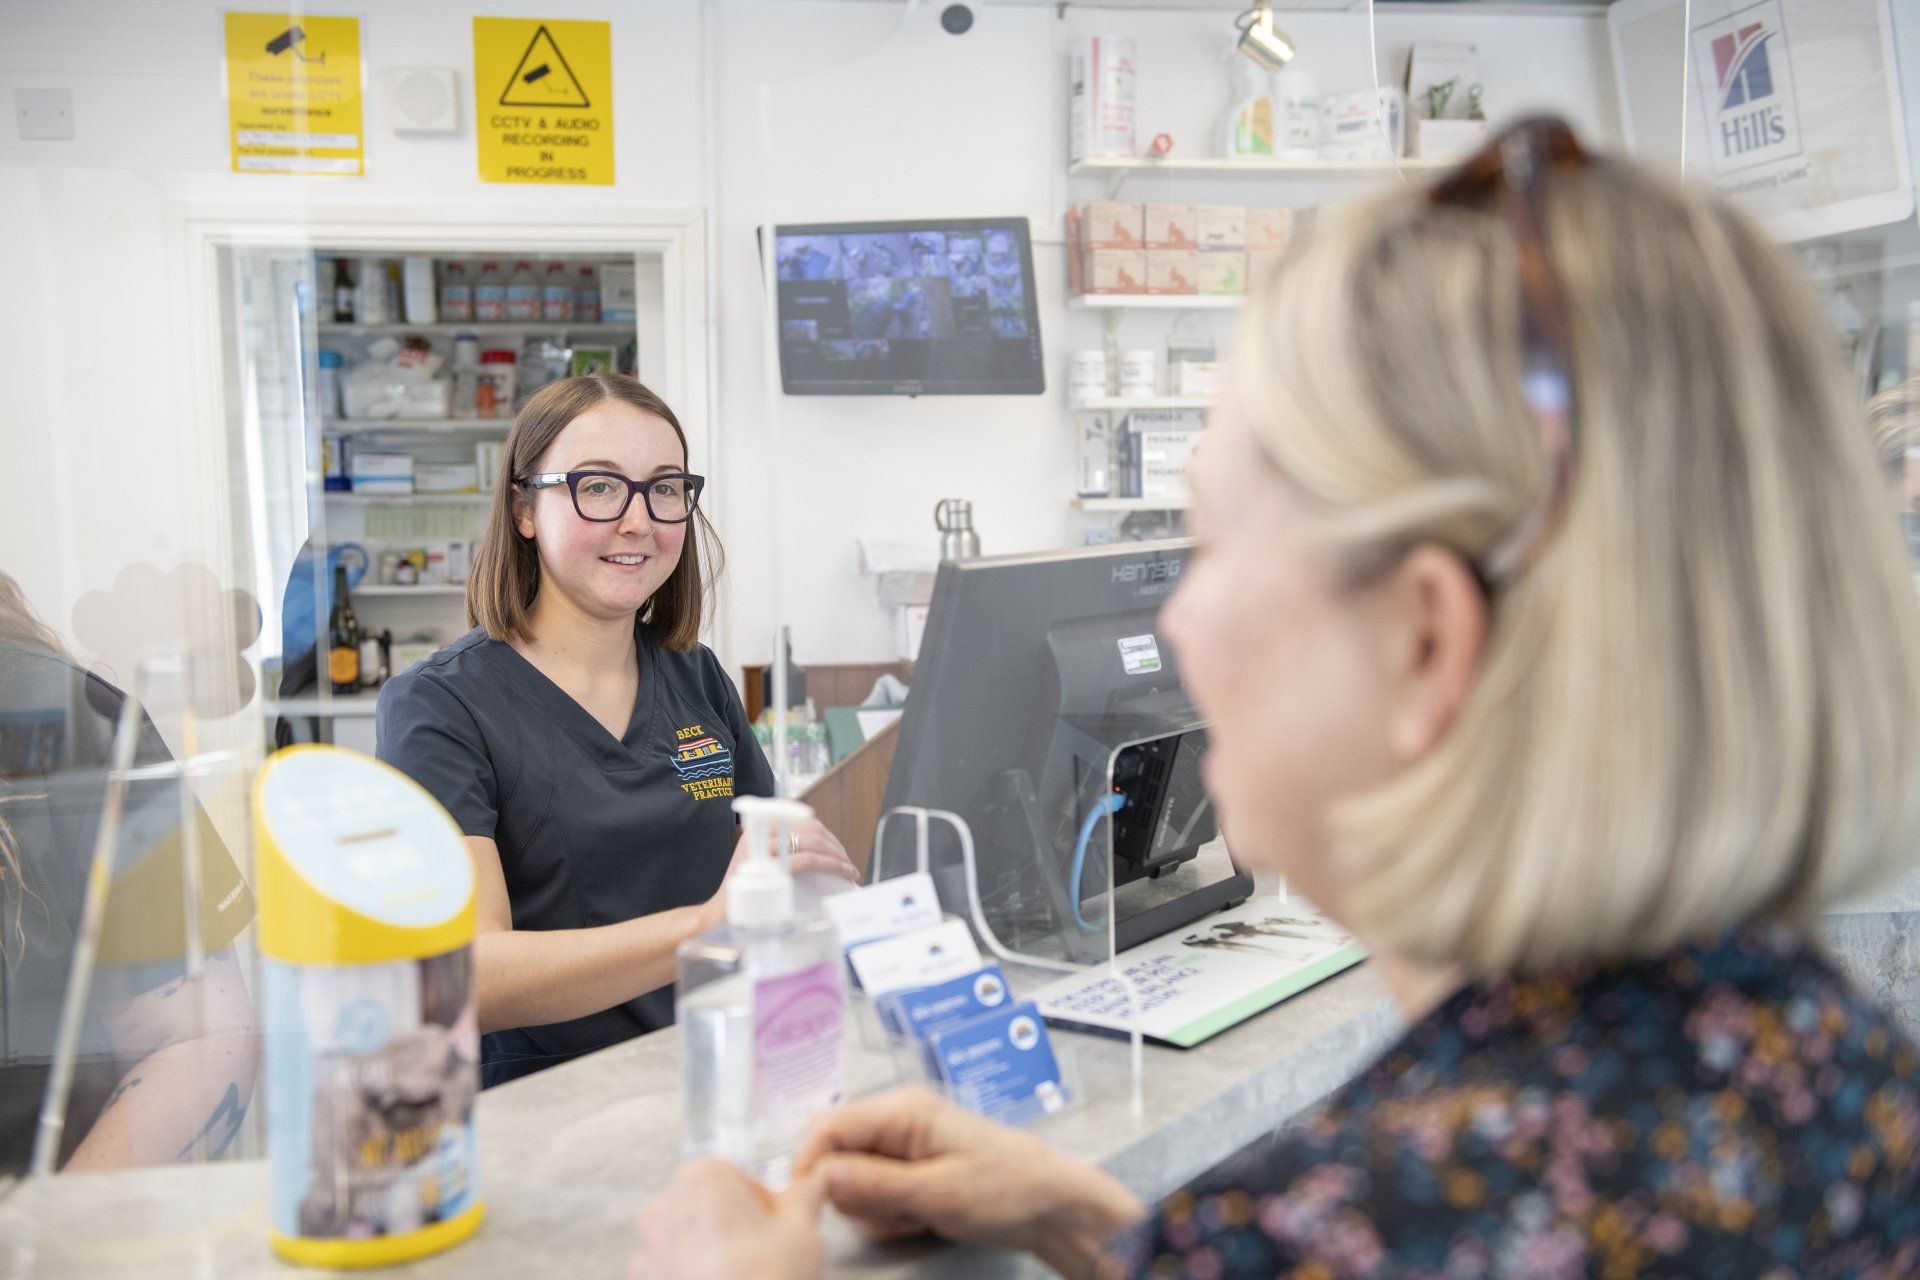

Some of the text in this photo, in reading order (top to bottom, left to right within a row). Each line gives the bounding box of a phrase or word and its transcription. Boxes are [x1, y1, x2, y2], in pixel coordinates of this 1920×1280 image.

[490, 115, 600, 131] CCTV & AUDIO
[1720, 108, 1786, 157] Hill's
[502, 133, 590, 147] RECORDING
[540, 151, 555, 162] IN
[506, 166, 588, 180] PROGRESS
[676, 725, 704, 740] BECK
